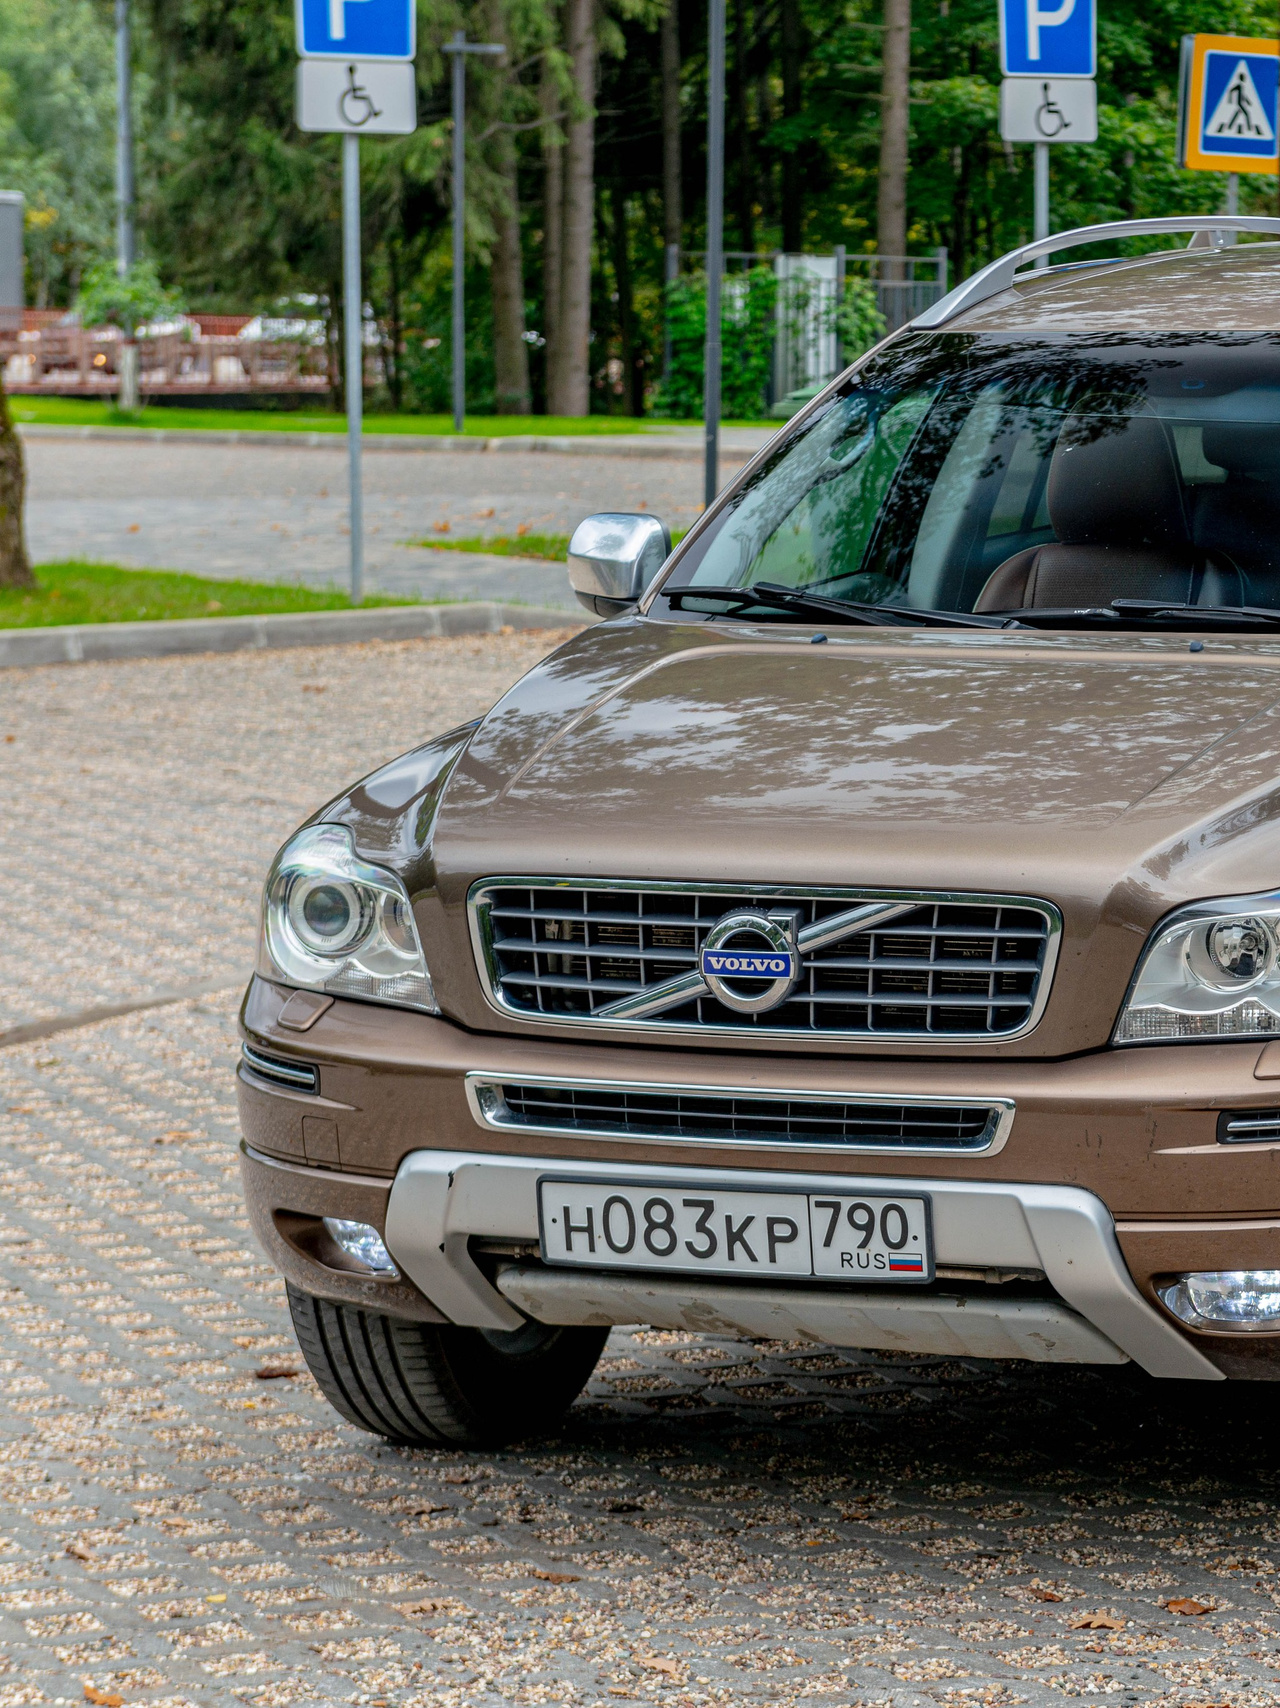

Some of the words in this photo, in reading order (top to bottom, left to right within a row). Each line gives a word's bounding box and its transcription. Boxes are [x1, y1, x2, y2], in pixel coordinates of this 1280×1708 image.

[707, 956, 786, 972] VOLVO
[814, 1200, 909, 1250] 790
[840, 1251, 887, 1270] RUS
